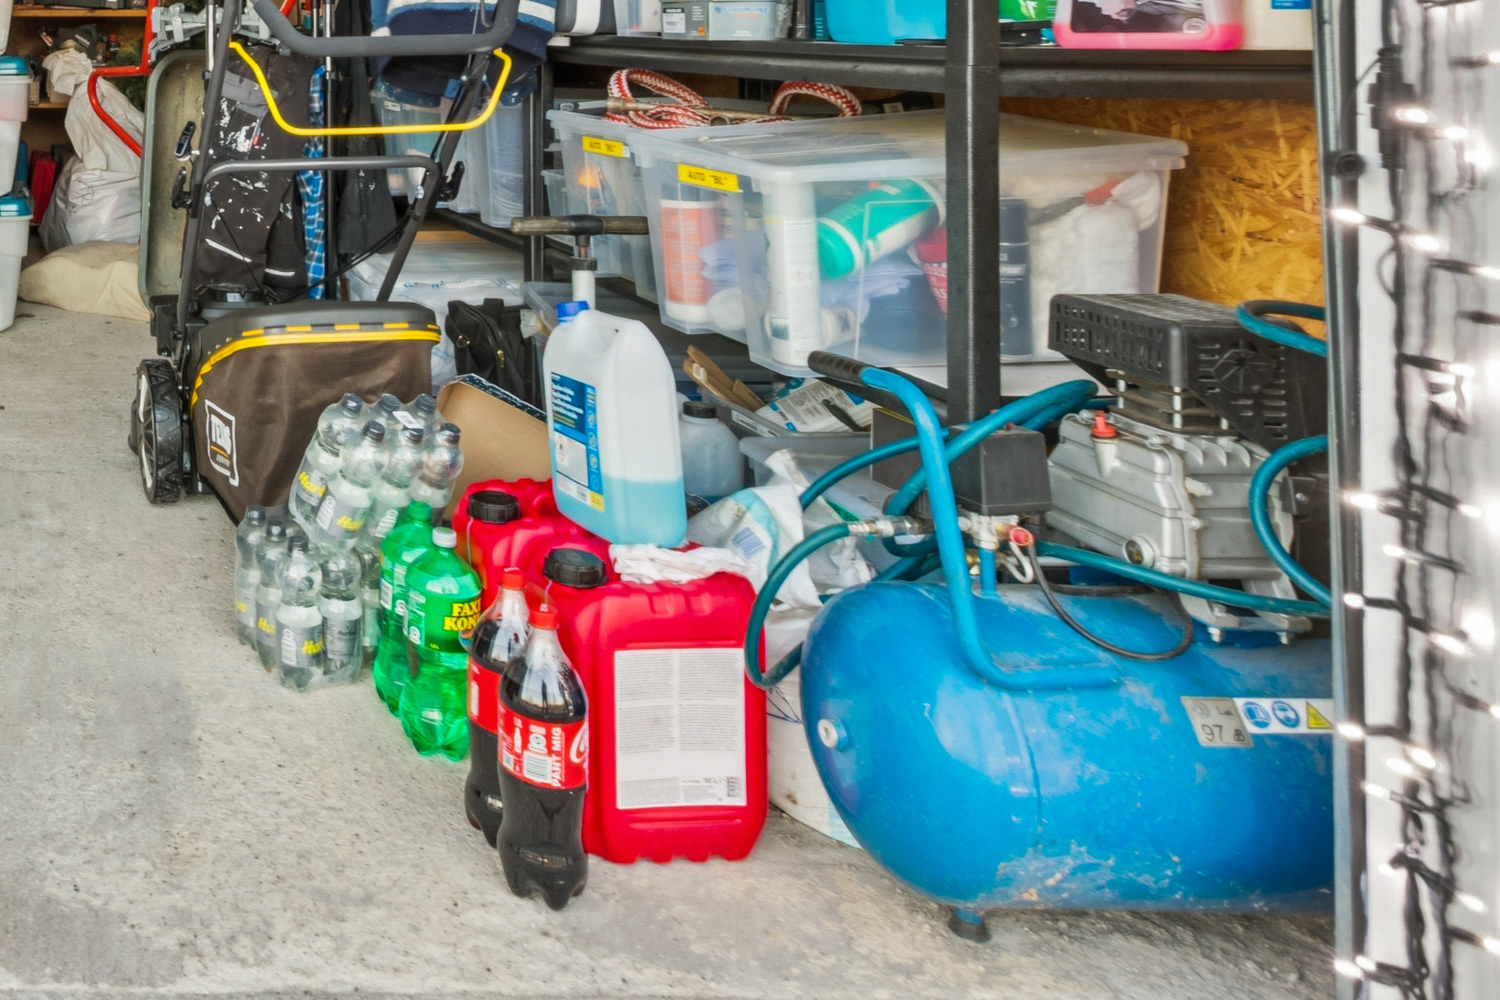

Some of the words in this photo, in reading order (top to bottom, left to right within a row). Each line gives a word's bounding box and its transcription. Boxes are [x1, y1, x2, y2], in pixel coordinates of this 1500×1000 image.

[452, 599, 482, 617] FAX
[443, 612, 480, 632] KON
[1202, 724, 1224, 742] 97
[551, 754, 563, 788] PANT
